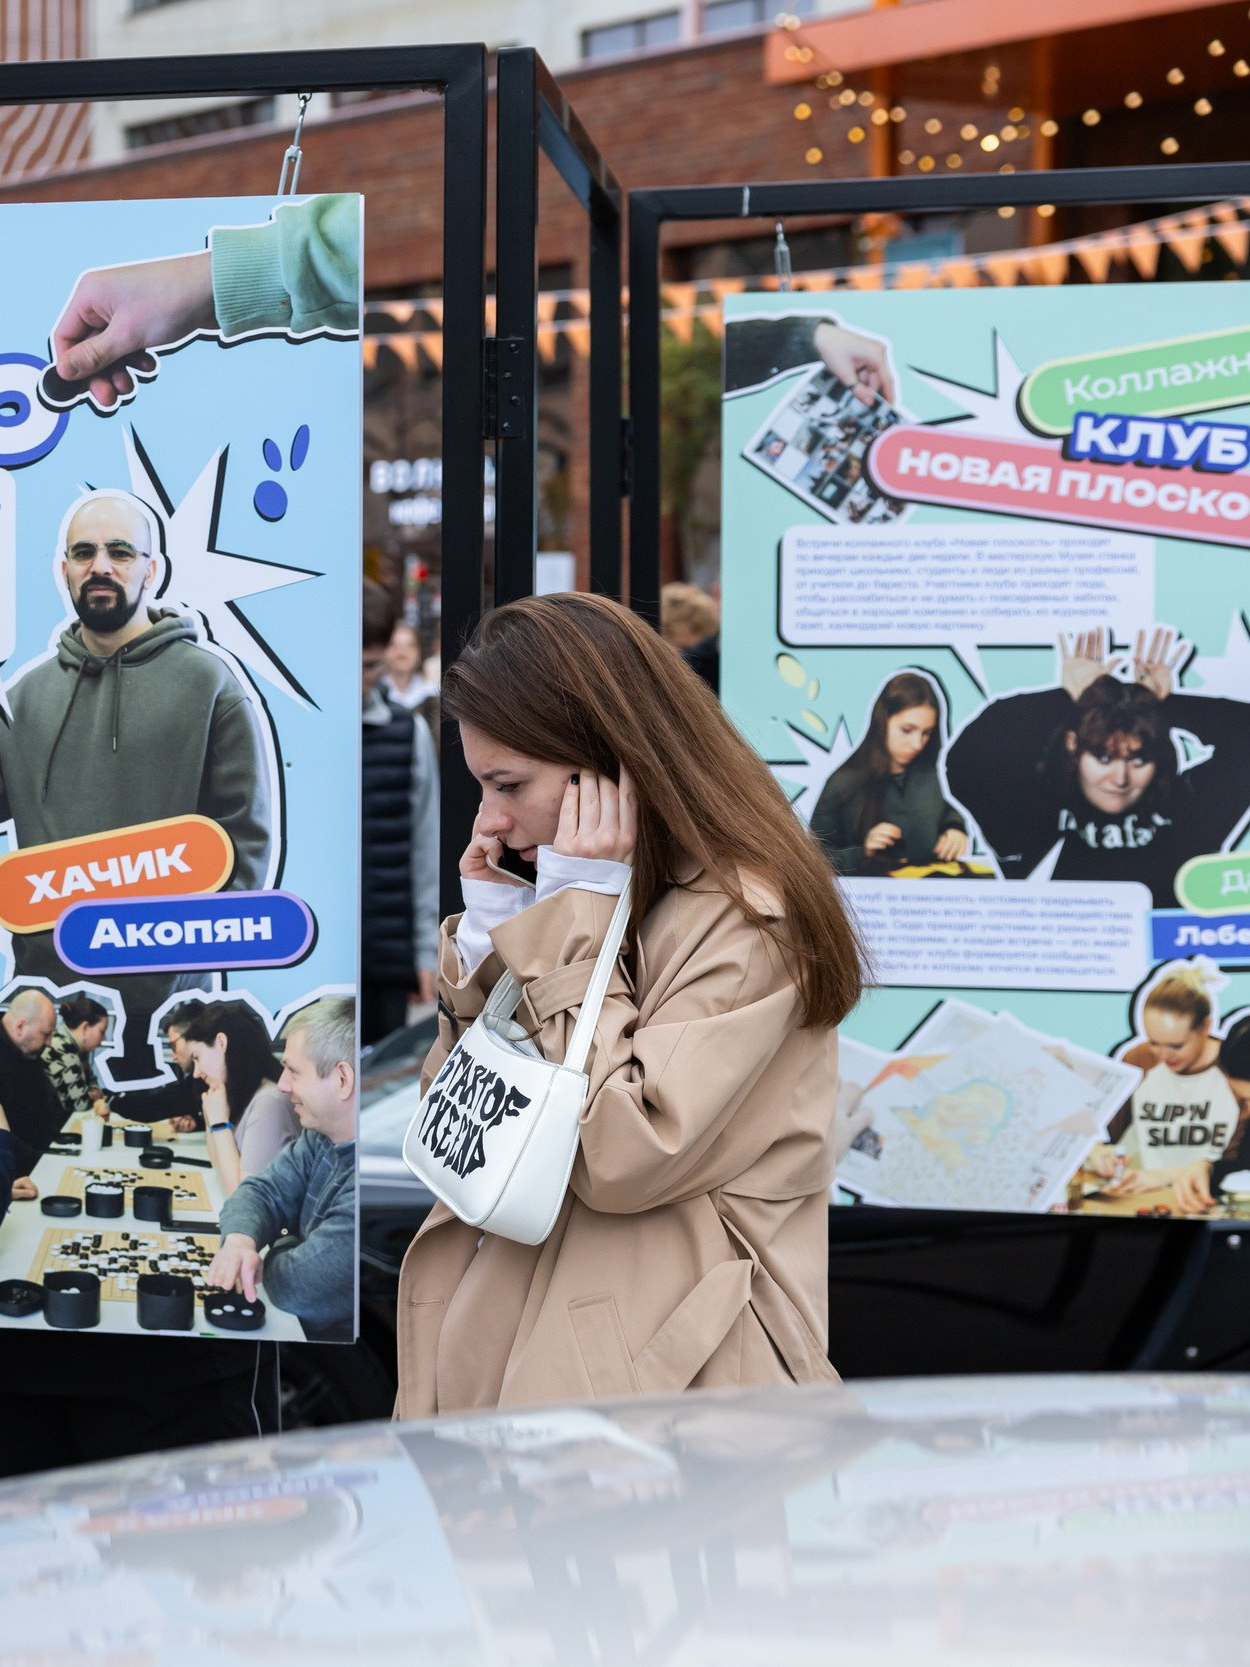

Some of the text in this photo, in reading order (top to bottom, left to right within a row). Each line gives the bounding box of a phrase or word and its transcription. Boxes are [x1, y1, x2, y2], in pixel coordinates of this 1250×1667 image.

[1063, 352, 1250, 405] Коллажн
[1075, 416, 1249, 466] КЛУБ
[897, 448, 1250, 521] НОВАЯ ПЛОСКО
[26, 842, 192, 904] ХАЧИК
[1220, 869, 1250, 896] Д
[89, 916, 272, 950] Акопян
[1174, 924, 1250, 947] Лебе
[1148, 1122, 1228, 1148] SLIDE
